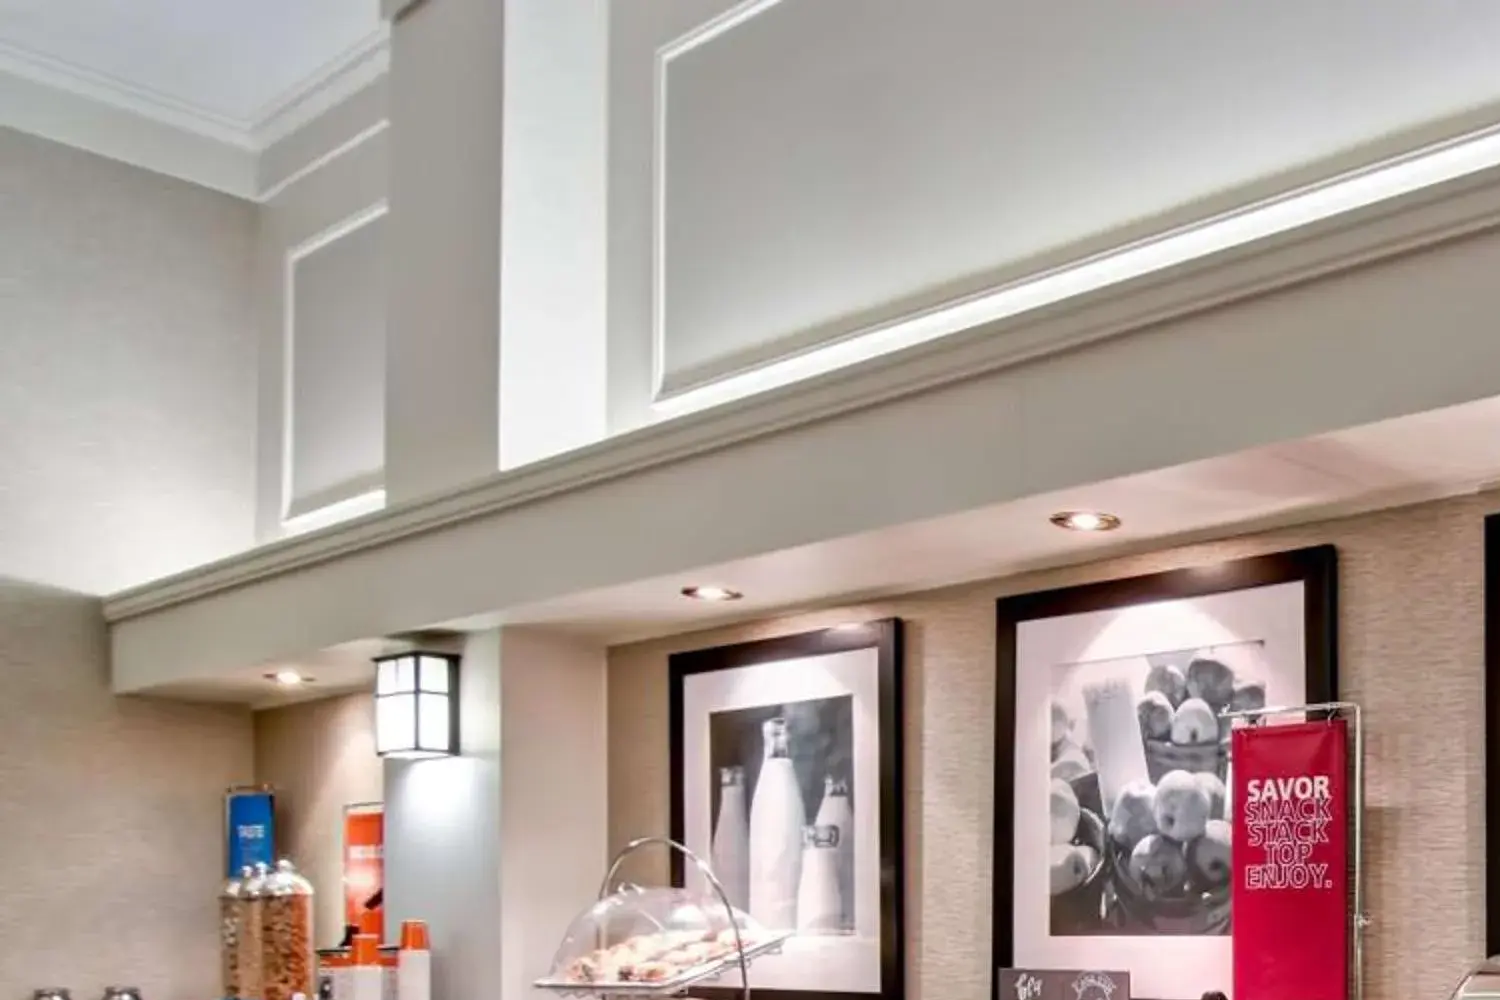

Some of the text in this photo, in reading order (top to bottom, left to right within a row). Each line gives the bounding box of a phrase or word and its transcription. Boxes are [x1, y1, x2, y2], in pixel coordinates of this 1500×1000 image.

[1247, 775, 1329, 802] SAVOR
[1244, 797, 1333, 824] SNACK
[1247, 819, 1329, 846] STACK
[1263, 841, 1313, 866] TOP
[1245, 863, 1333, 889] ENJOY.
